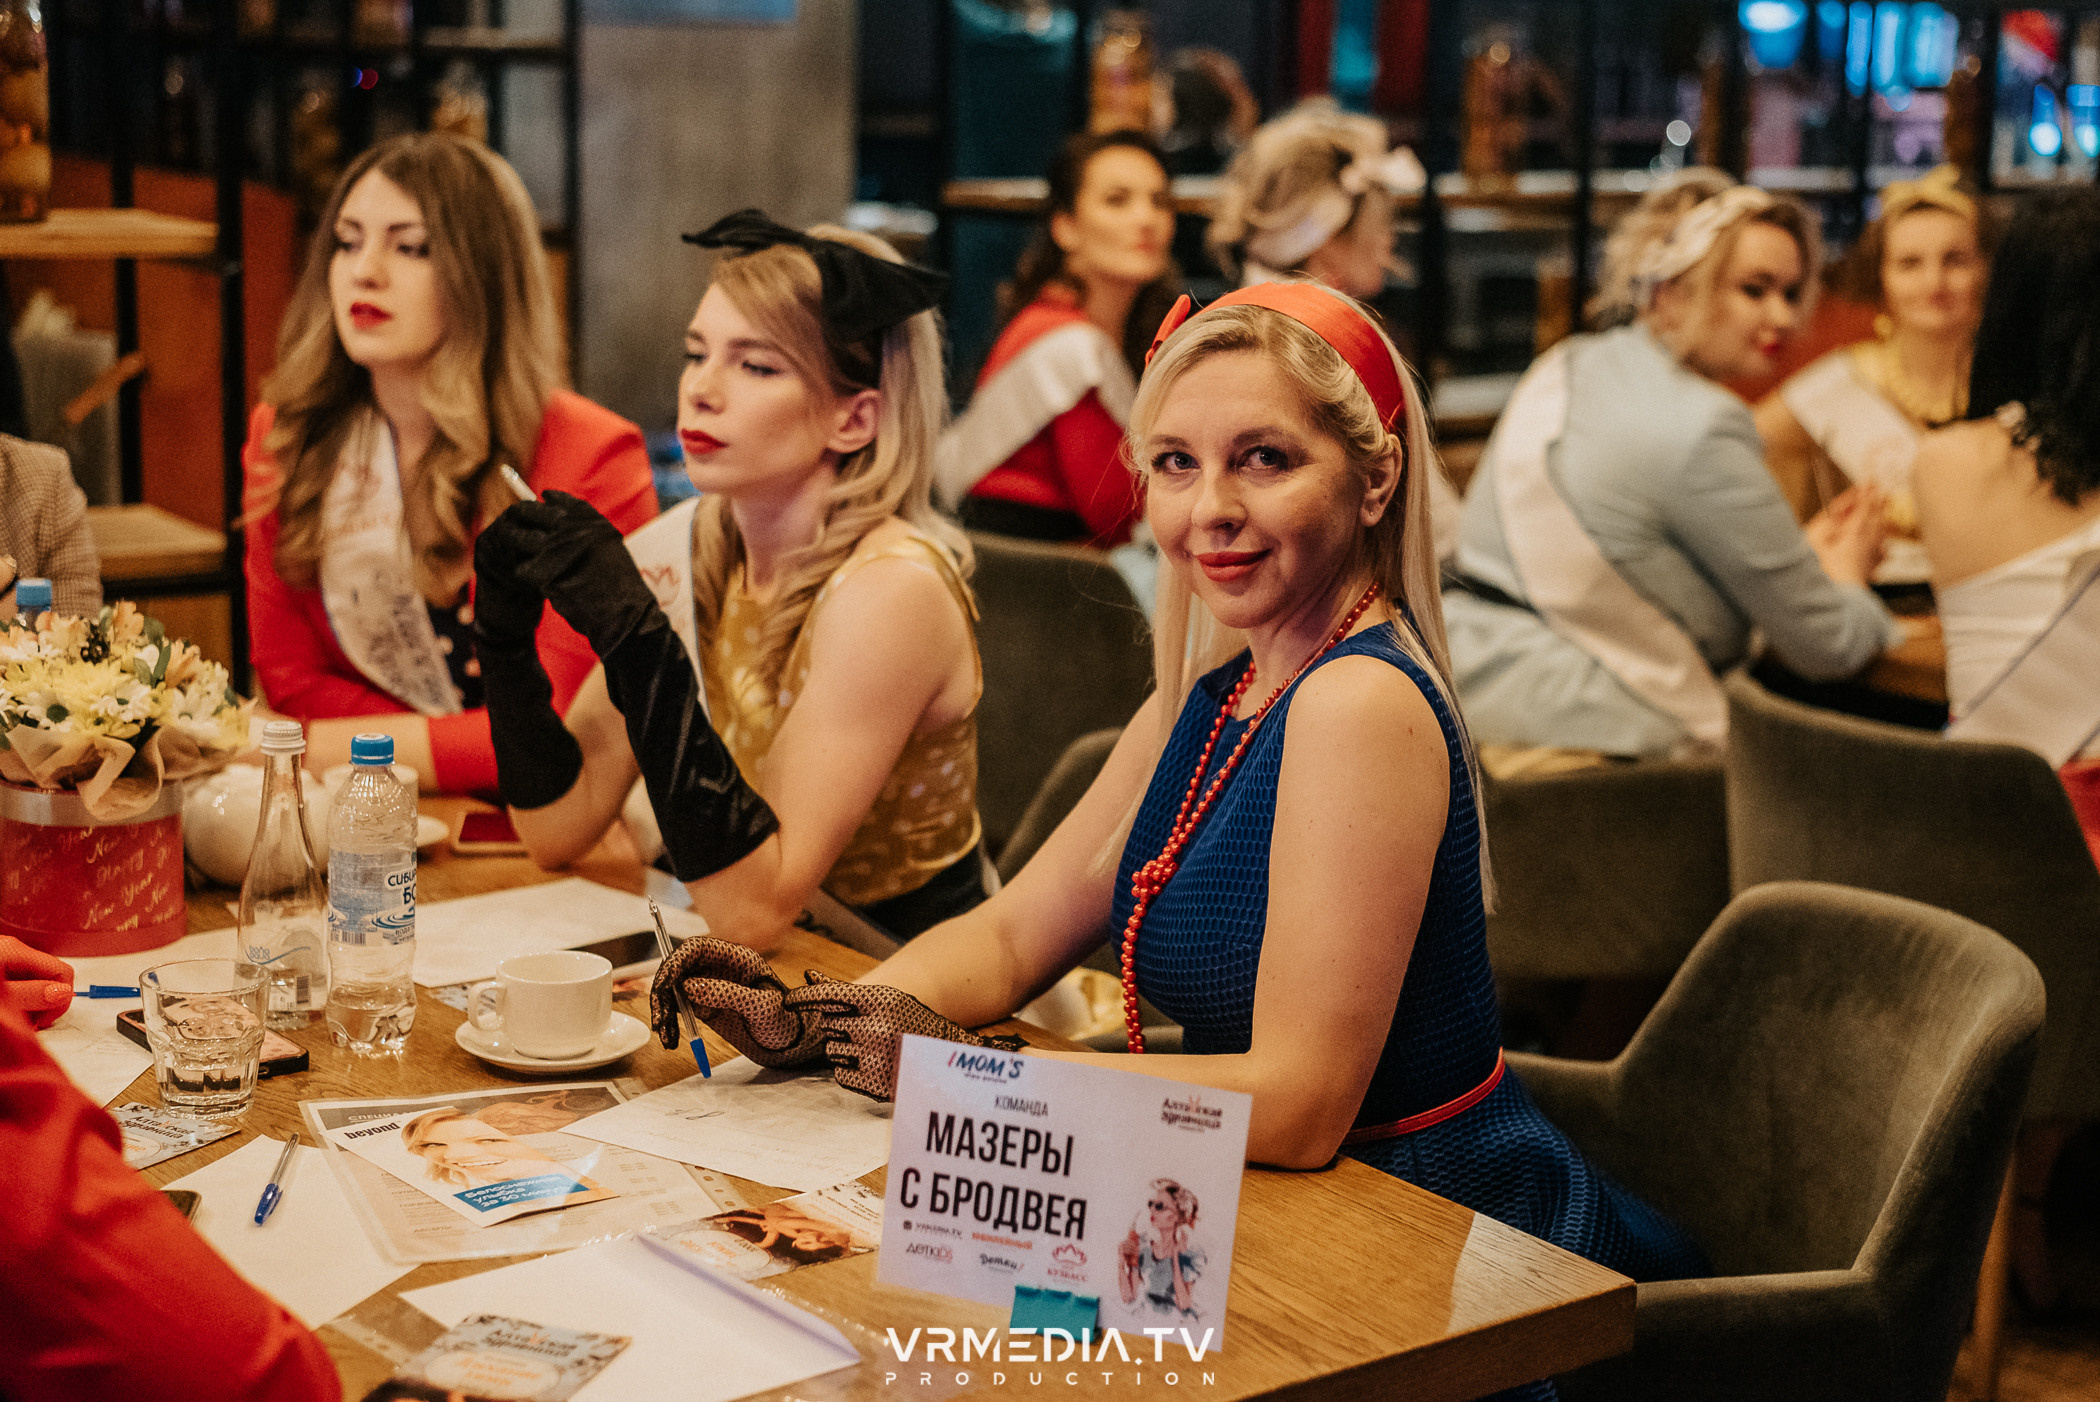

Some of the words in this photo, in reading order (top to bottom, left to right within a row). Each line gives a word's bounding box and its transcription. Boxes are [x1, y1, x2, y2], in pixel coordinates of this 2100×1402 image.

[994, 1095, 1049, 1117] КОМАНДА
[344, 1122, 401, 1139] beyond
[925, 1110, 1074, 1177] МАЗЕРЫ
[899, 1167, 922, 1209] С
[929, 1172, 1088, 1241] БРОДВЕЯ
